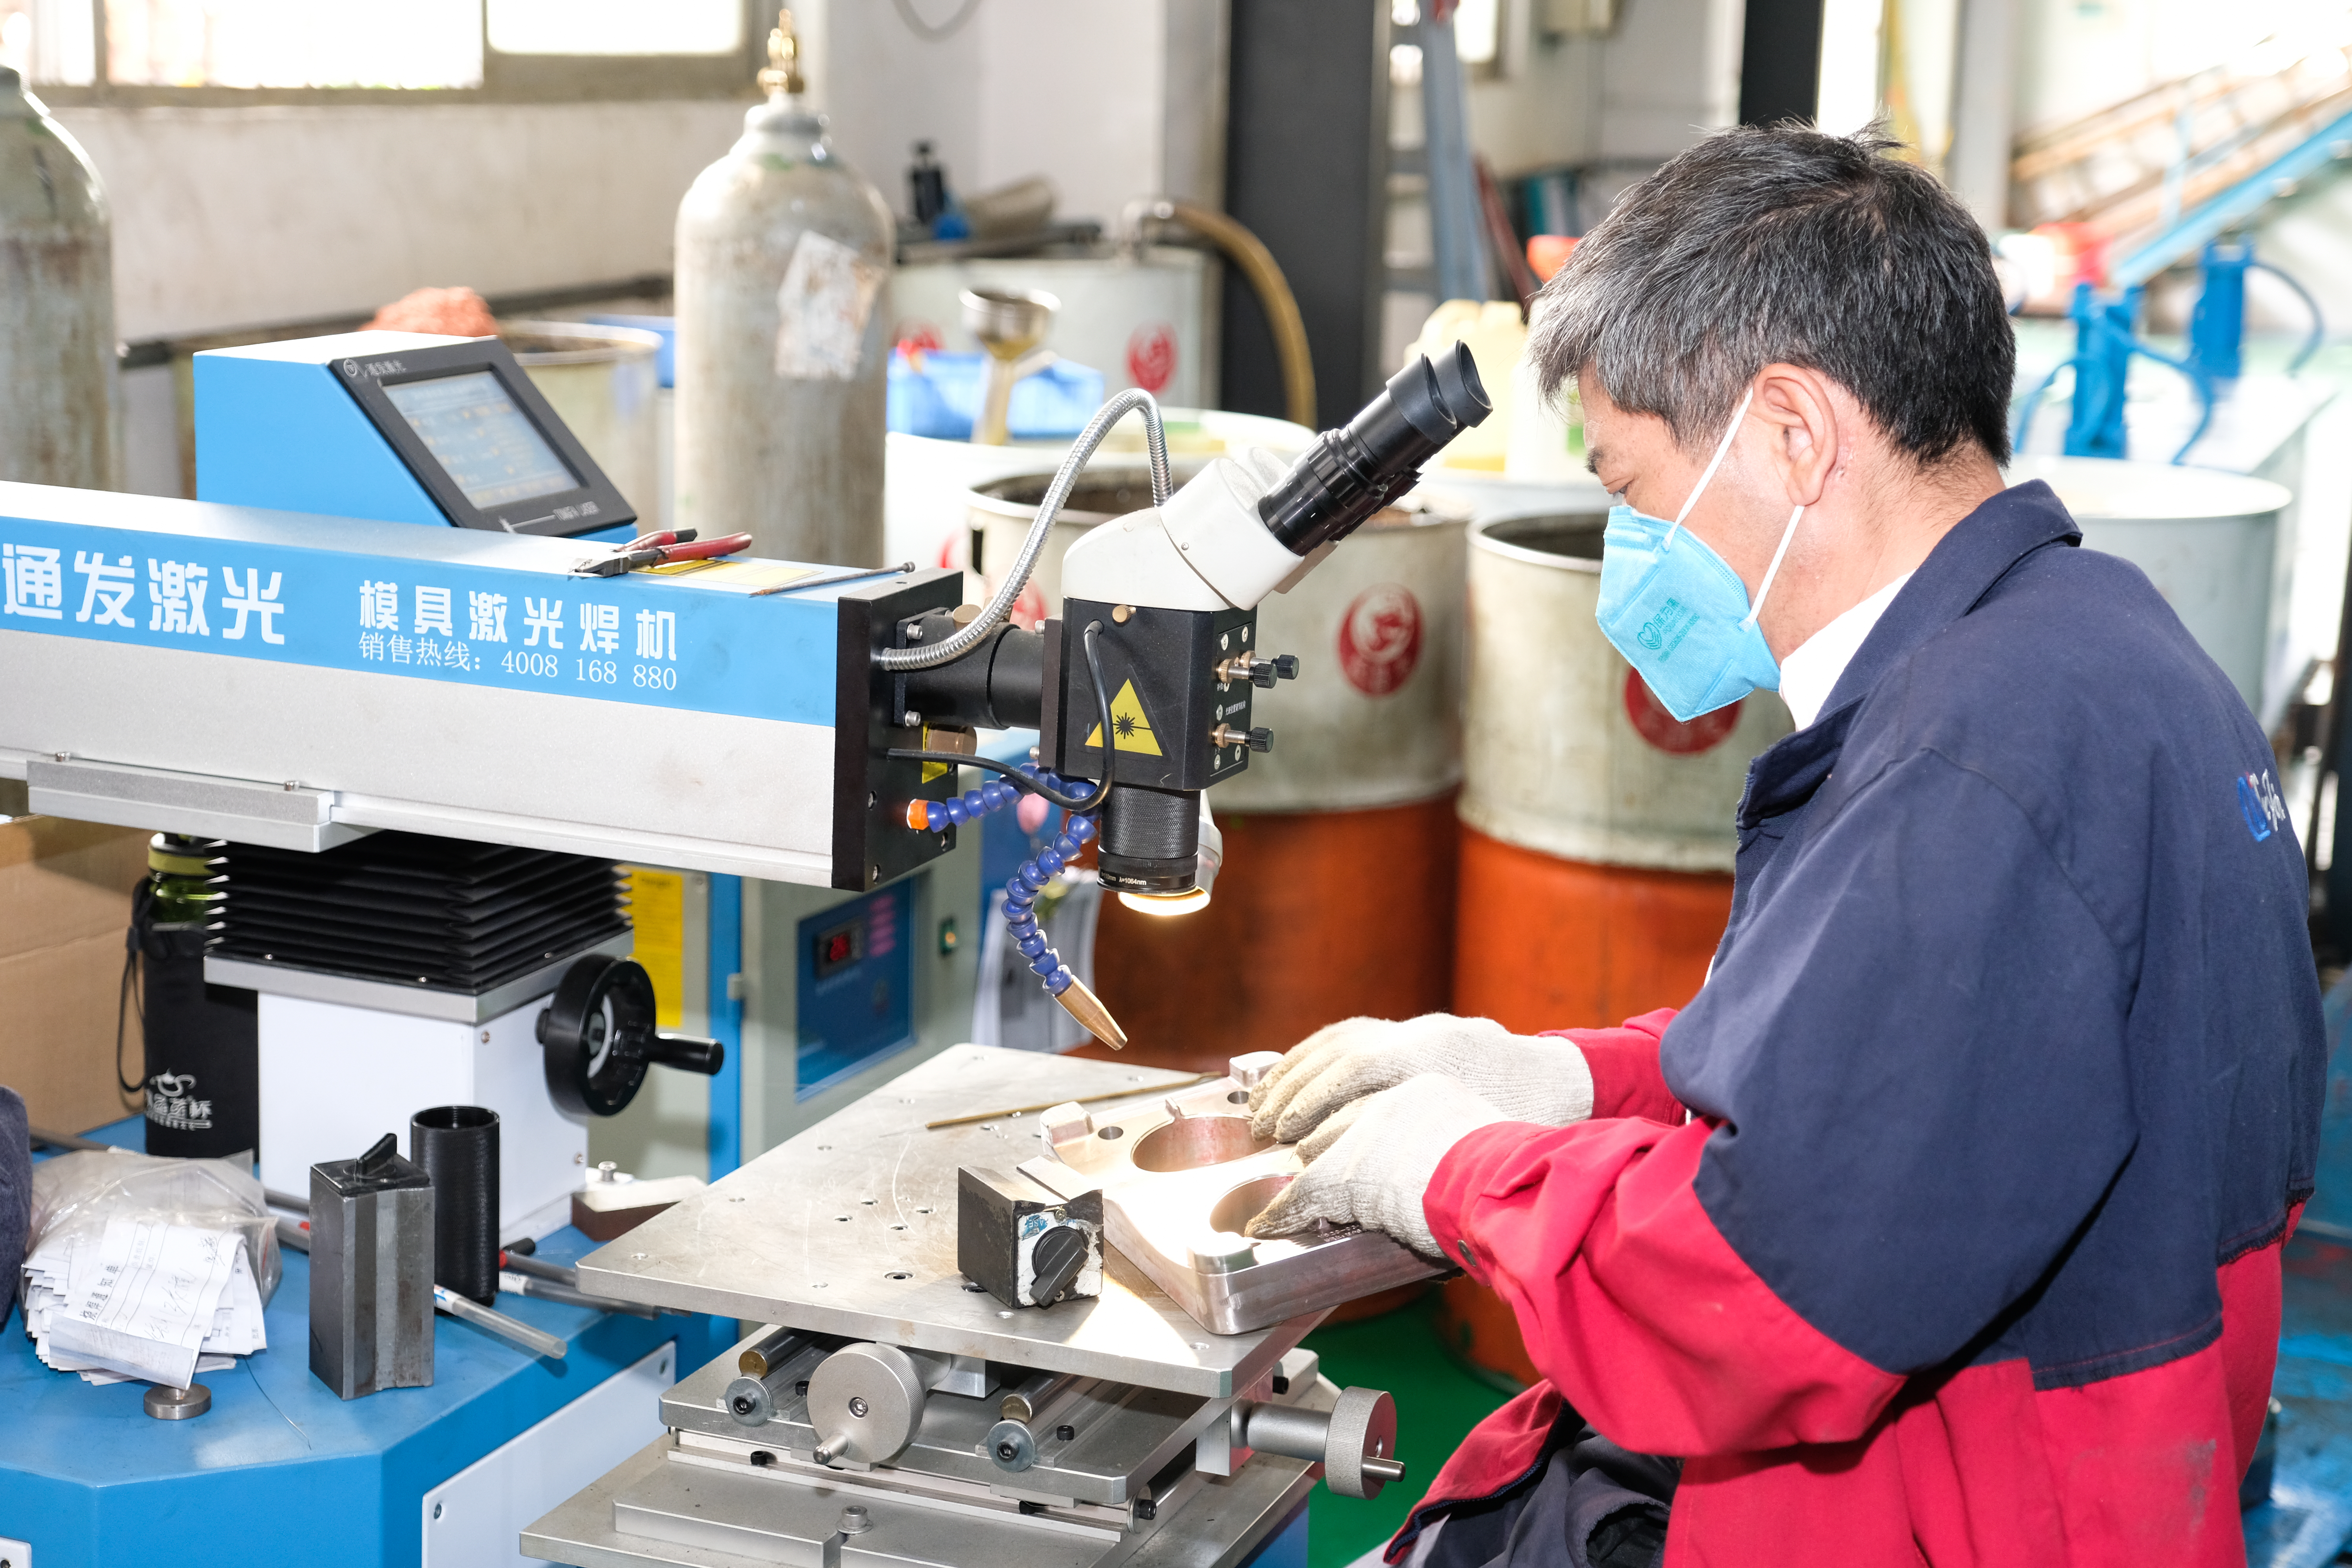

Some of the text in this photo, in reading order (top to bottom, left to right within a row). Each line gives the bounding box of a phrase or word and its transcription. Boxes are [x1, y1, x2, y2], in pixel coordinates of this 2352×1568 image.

[2, 543, 285, 645] 通发激光
[359, 580, 676, 661] 模具激光焊机
[501, 651, 558, 678] 4008
[576, 659, 617, 684] 168
[633, 664, 677, 690] 880
[1119, 877, 1147, 886] λ=1064nm
